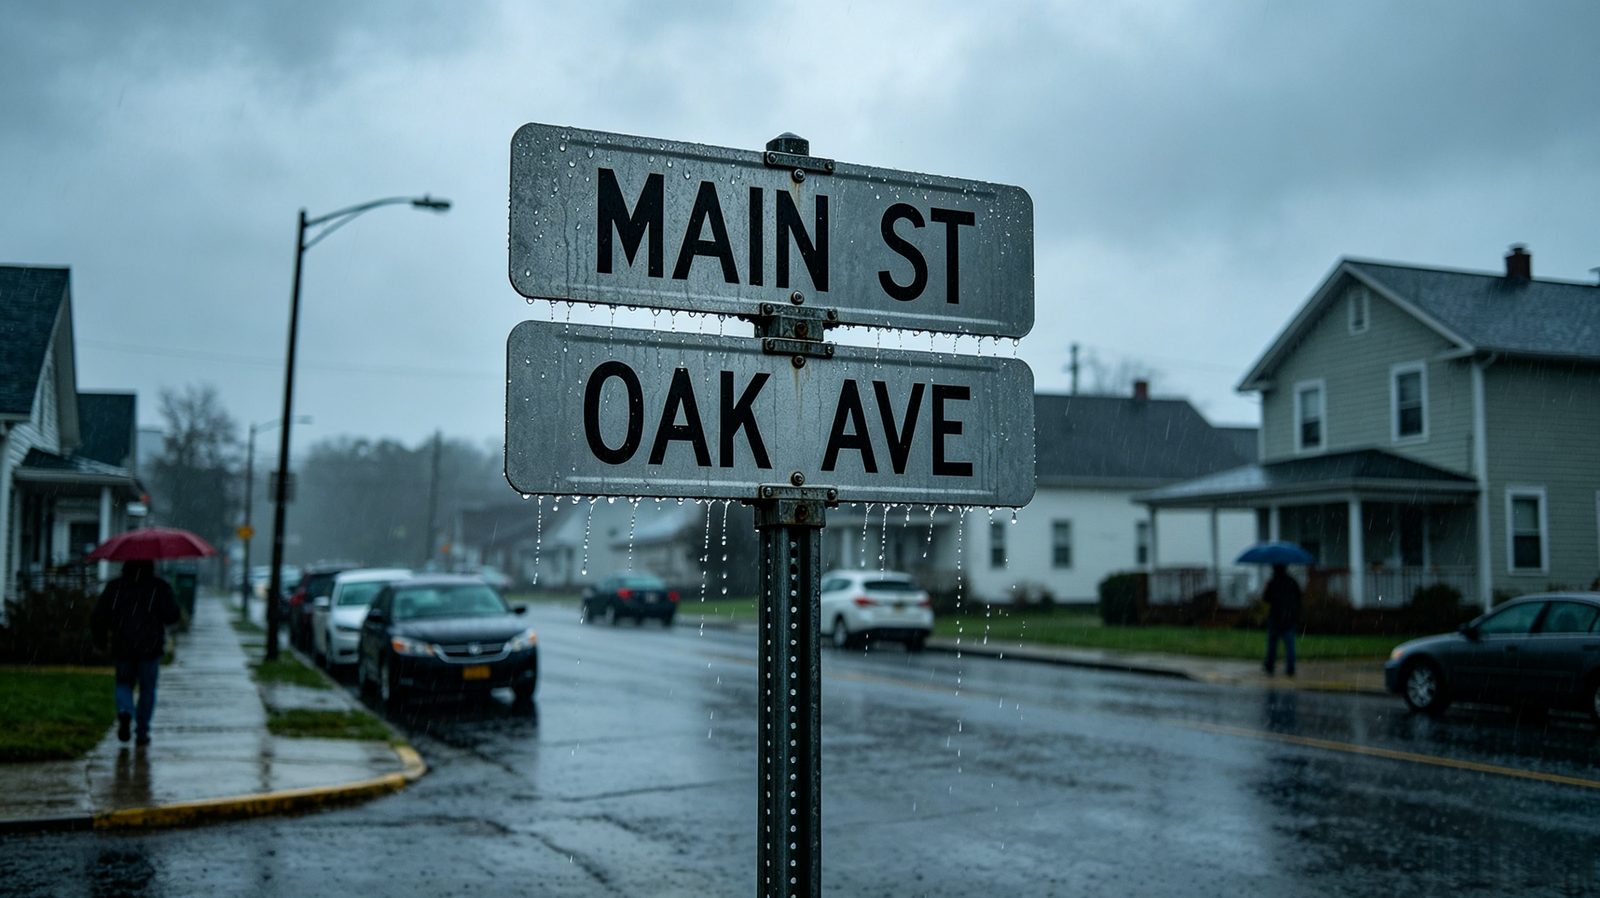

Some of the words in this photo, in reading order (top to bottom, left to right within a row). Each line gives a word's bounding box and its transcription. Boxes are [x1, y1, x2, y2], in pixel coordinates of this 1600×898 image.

[597, 168, 829, 293] MAIN
[878, 202, 976, 305] ST
[584, 361, 772, 470] OAK
[821, 378, 973, 477] AVE
